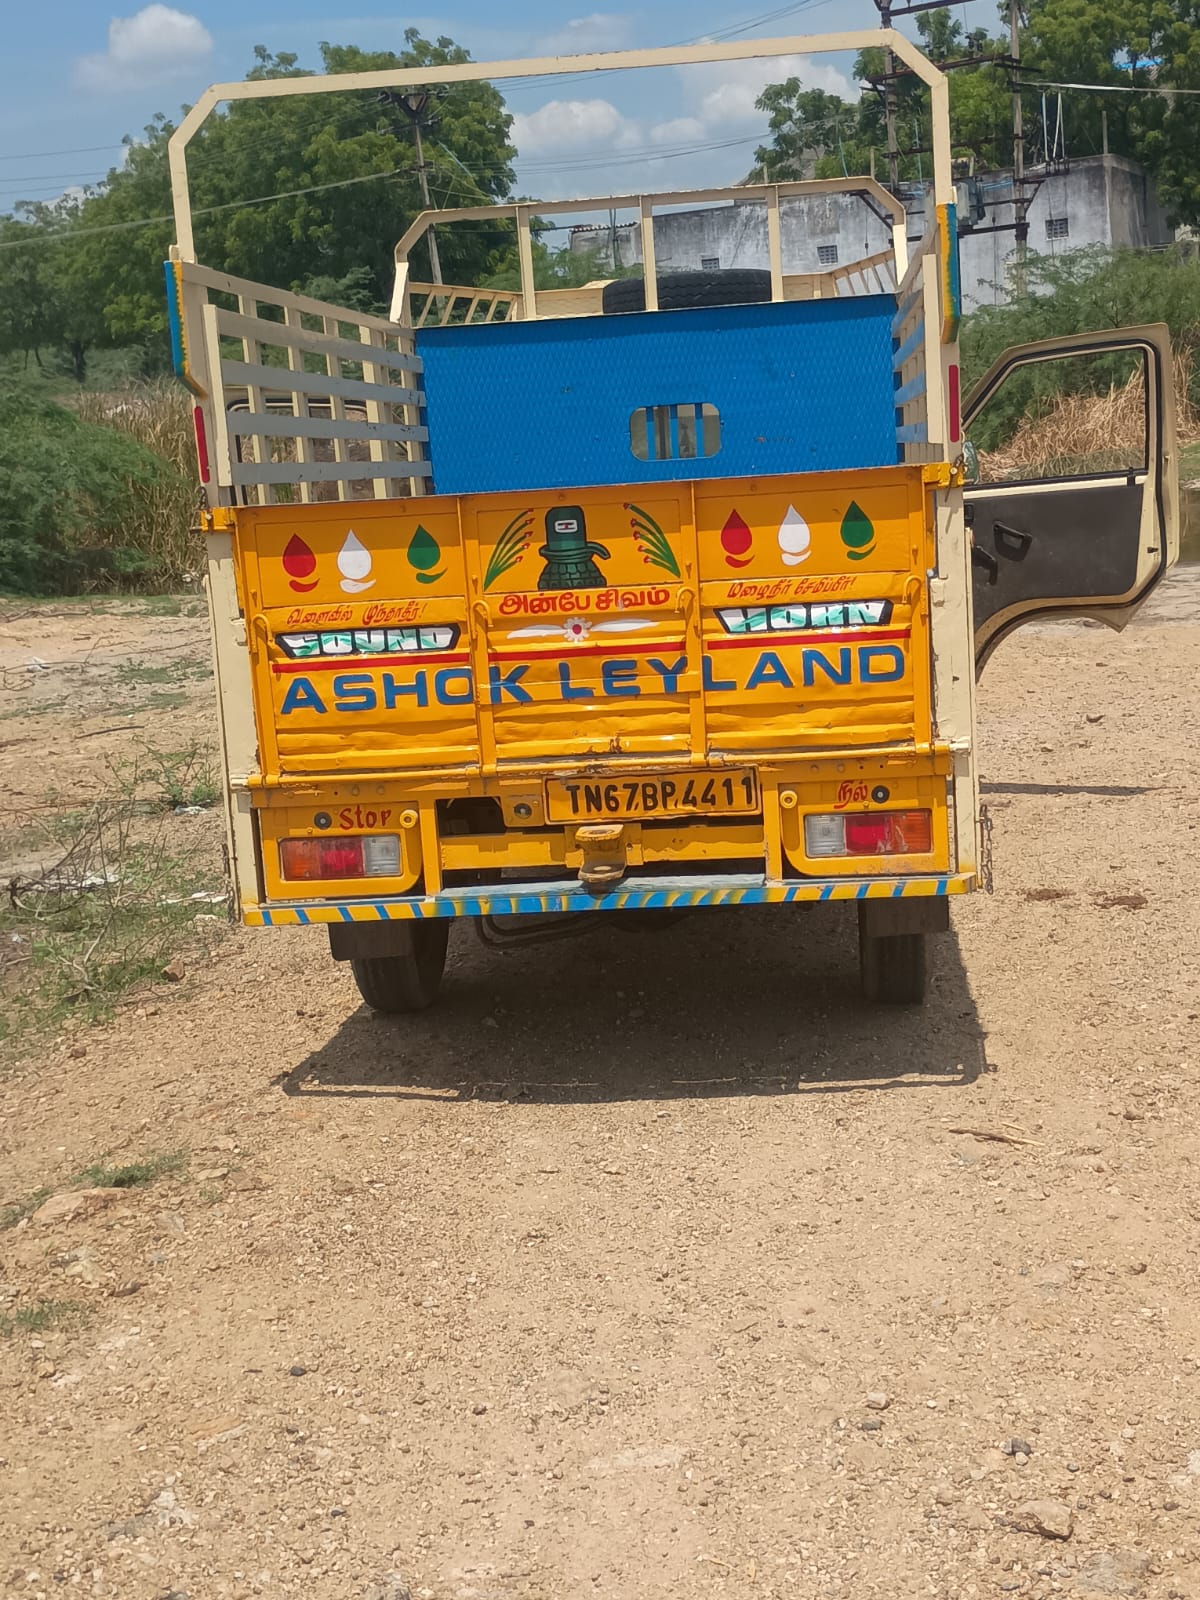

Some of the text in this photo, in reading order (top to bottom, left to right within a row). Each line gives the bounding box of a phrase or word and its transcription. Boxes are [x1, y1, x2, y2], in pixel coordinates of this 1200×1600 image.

[499, 587, 671, 615] அன்பே சிவம்
[282, 627, 454, 657] SOUND
[281, 645, 905, 715] ASHOK LEYLAND
